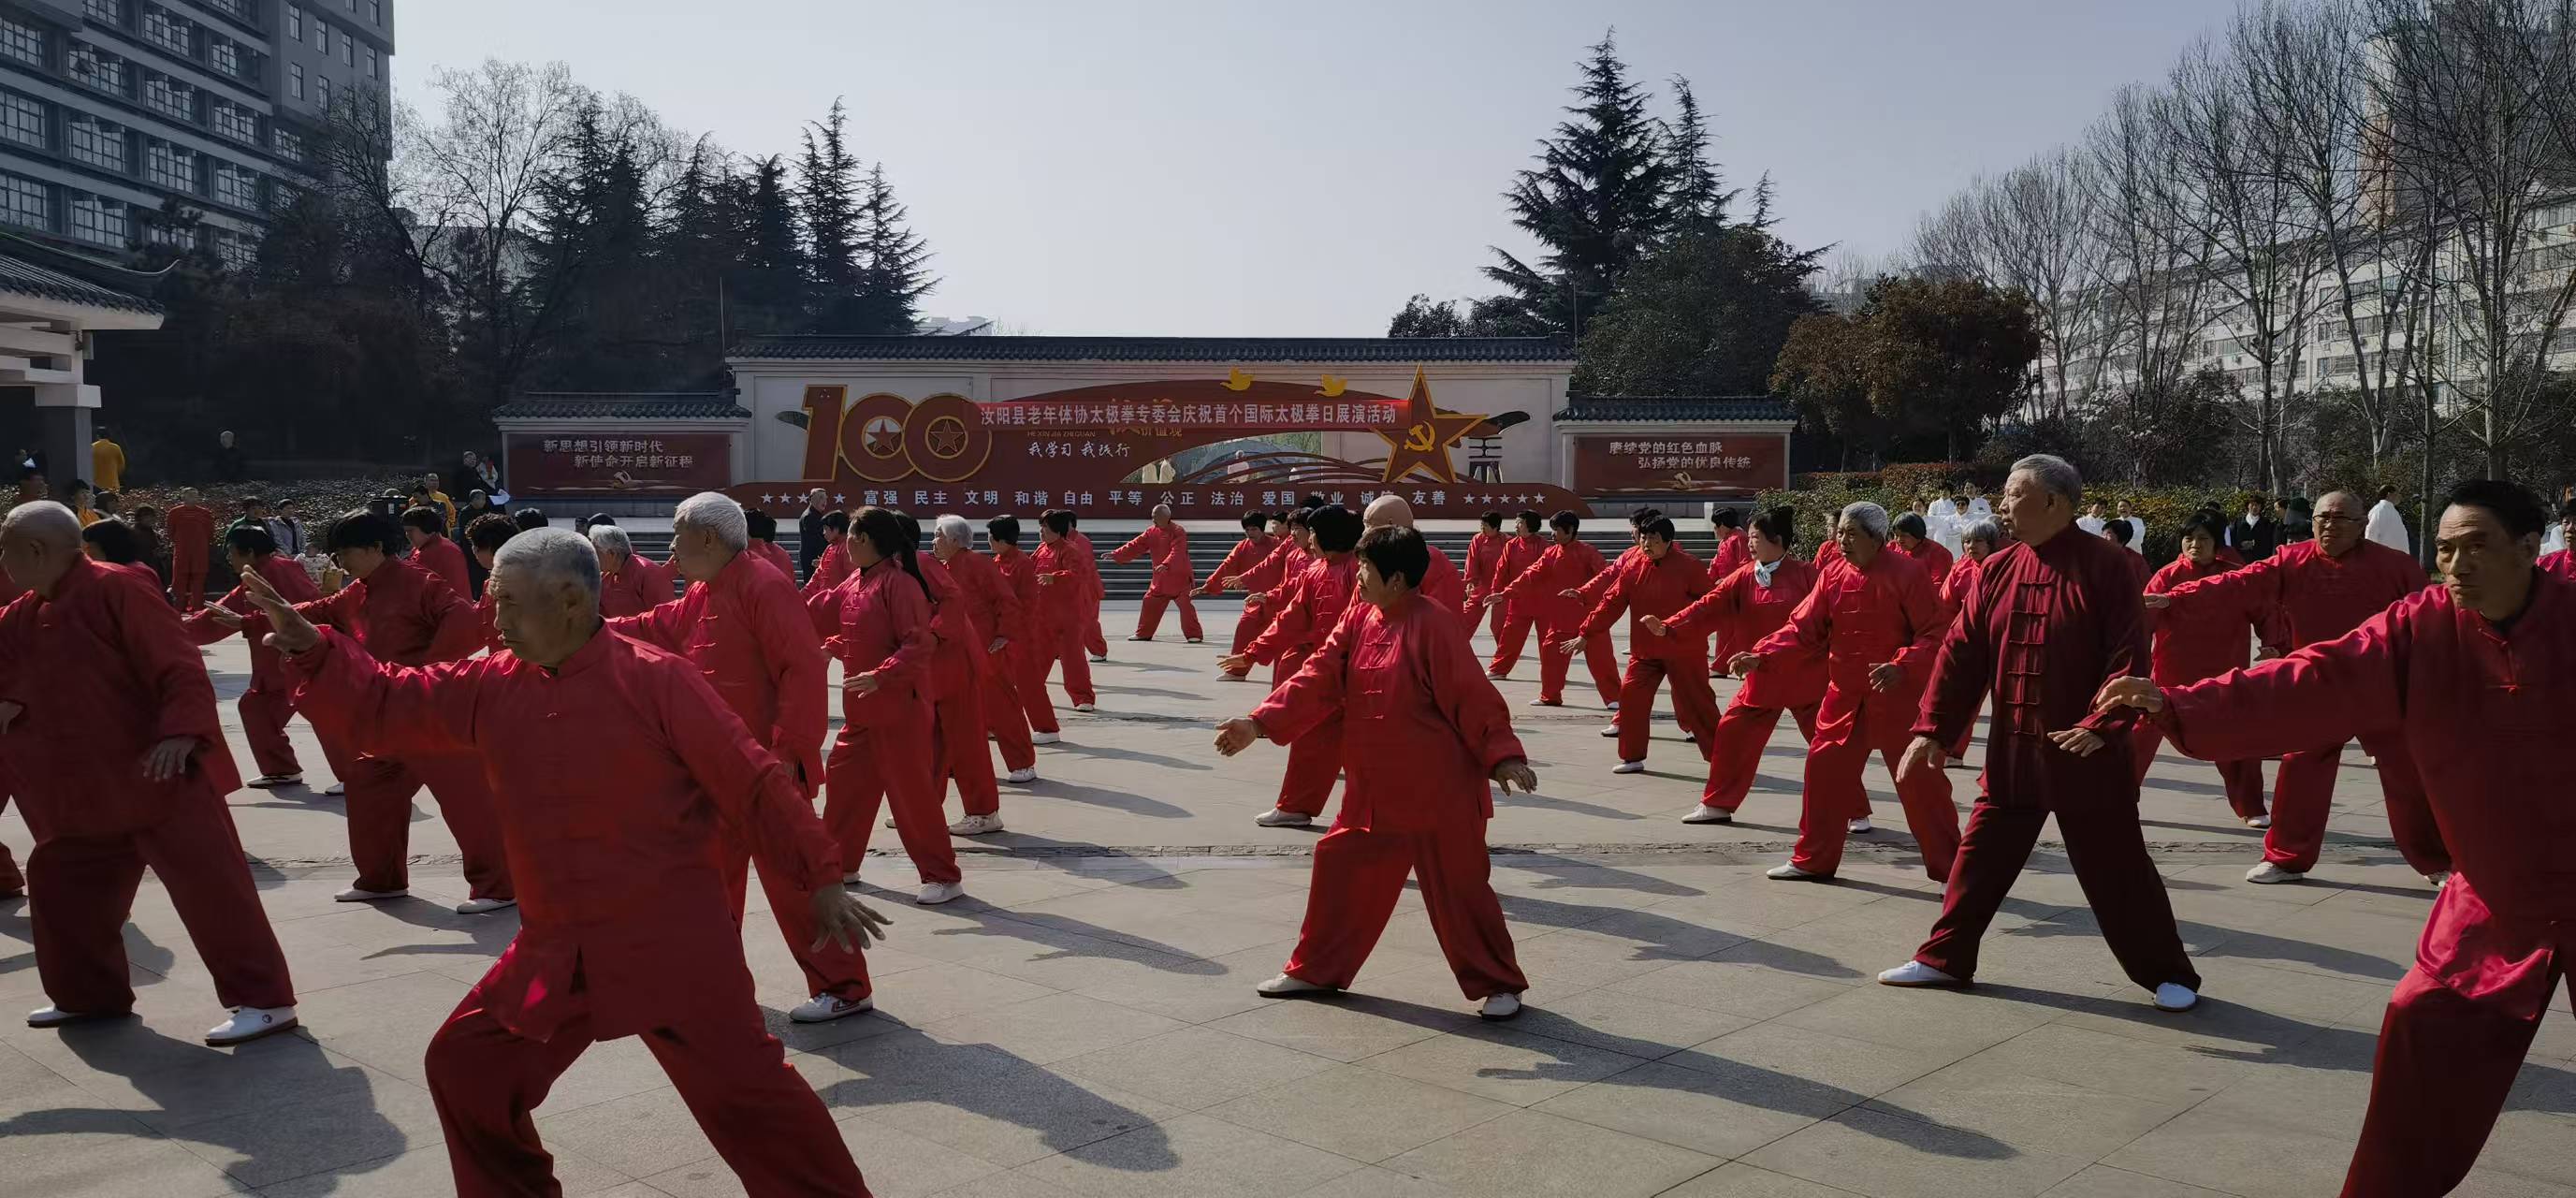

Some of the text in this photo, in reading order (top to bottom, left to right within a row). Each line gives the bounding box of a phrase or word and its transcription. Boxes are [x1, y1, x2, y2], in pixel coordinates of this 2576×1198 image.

[980, 402, 1396, 425] 汝阳县老年体协太极拳专委会庆祝首个国际太极拳日展演活动
[801, 384, 993, 482] 100
[544, 439, 663, 453] 新思想引领新时代
[1028, 442, 1071, 458] 我学习
[1608, 441, 1723, 455] 赓续党的红色血脉
[574, 455, 693, 468] 新使命开启新征程
[1637, 456, 1752, 469] 弘扬党的优良传统
[864, 490, 898, 505] 富强
[914, 490, 948, 505] 民主
[965, 490, 998, 505] 文明
[1014, 490, 1049, 505] 和谐
[1064, 490, 1093, 505] 自由
[1108, 490, 1142, 505] 平等
[1159, 490, 1195, 505] 公正
[1211, 490, 1244, 505] 法治
[1261, 490, 1295, 505] 爱国
[1361, 490, 1395, 505] 诚
[1412, 490, 1446, 505] 友善
